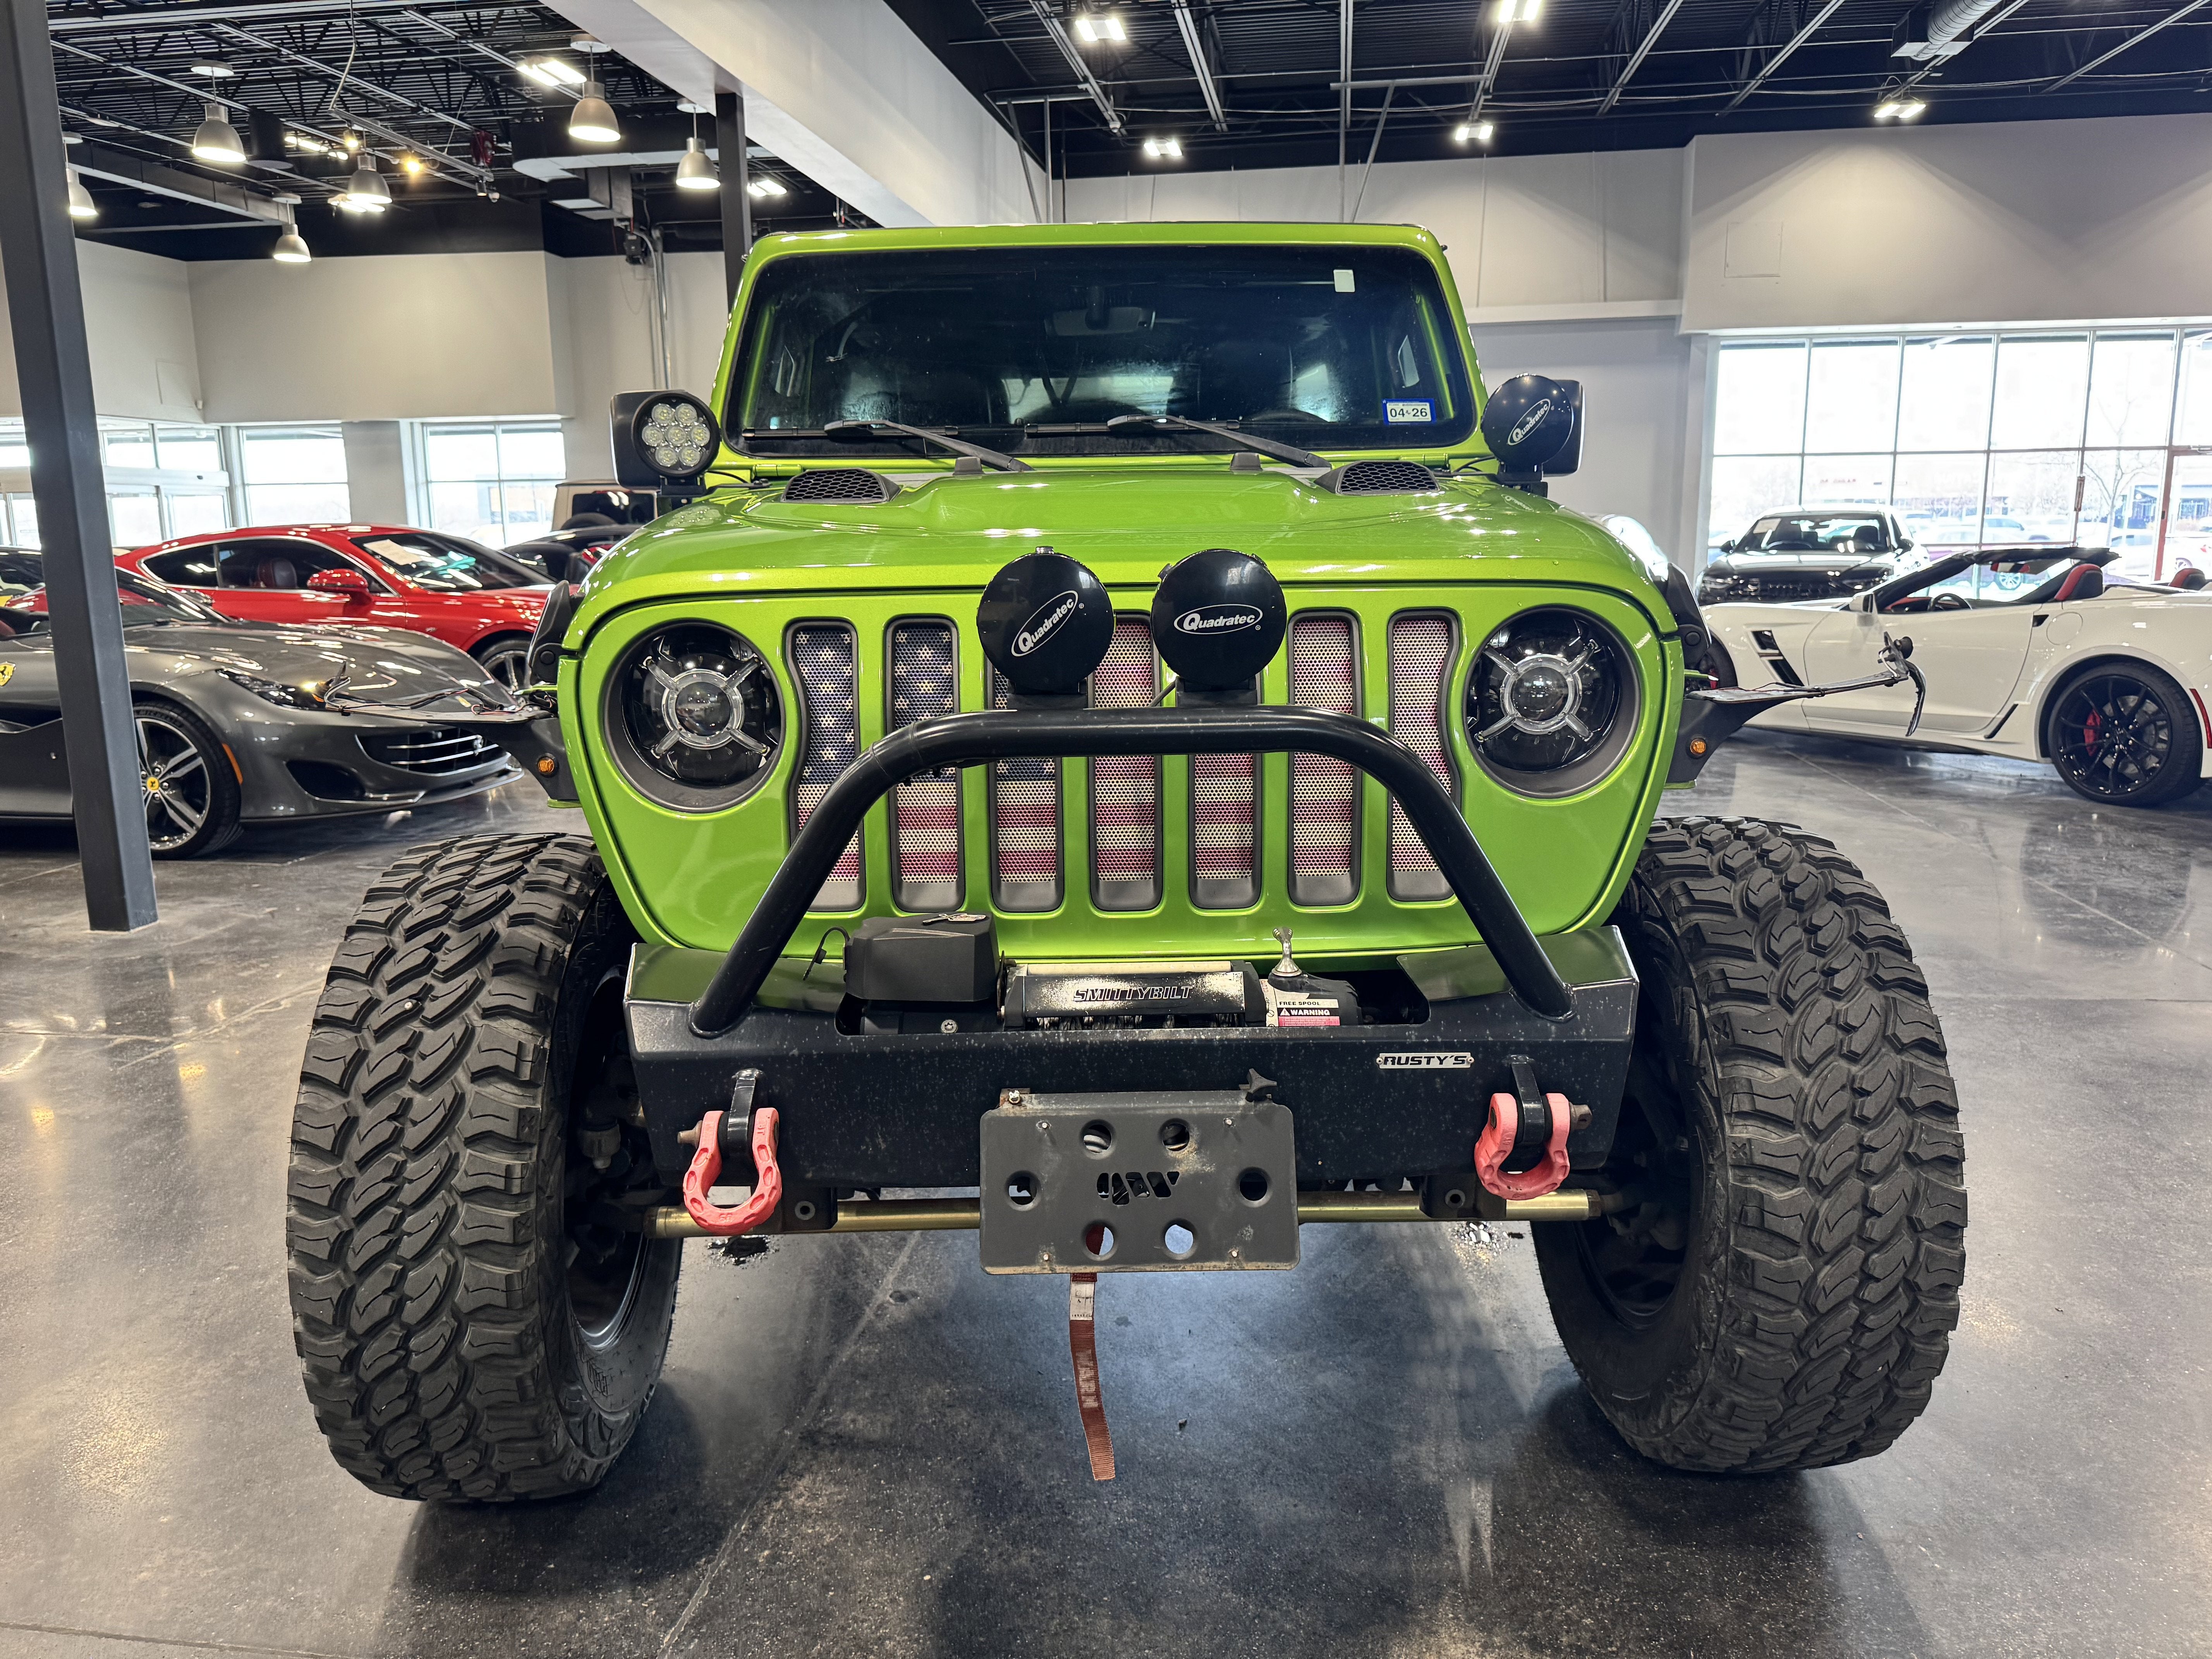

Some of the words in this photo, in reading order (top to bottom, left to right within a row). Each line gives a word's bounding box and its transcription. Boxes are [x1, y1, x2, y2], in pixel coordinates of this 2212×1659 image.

[1390, 409, 1405, 417] 04
[1412, 408, 1427, 417] 26
[1513, 404, 1548, 442] Quadratec
[1018, 599, 1074, 652] Quadratec
[1183, 613, 1255, 630] Quadratec
[1073, 986, 1193, 1001] SMITTYBILT
[1384, 1055, 1467, 1065] RUSTY'S
